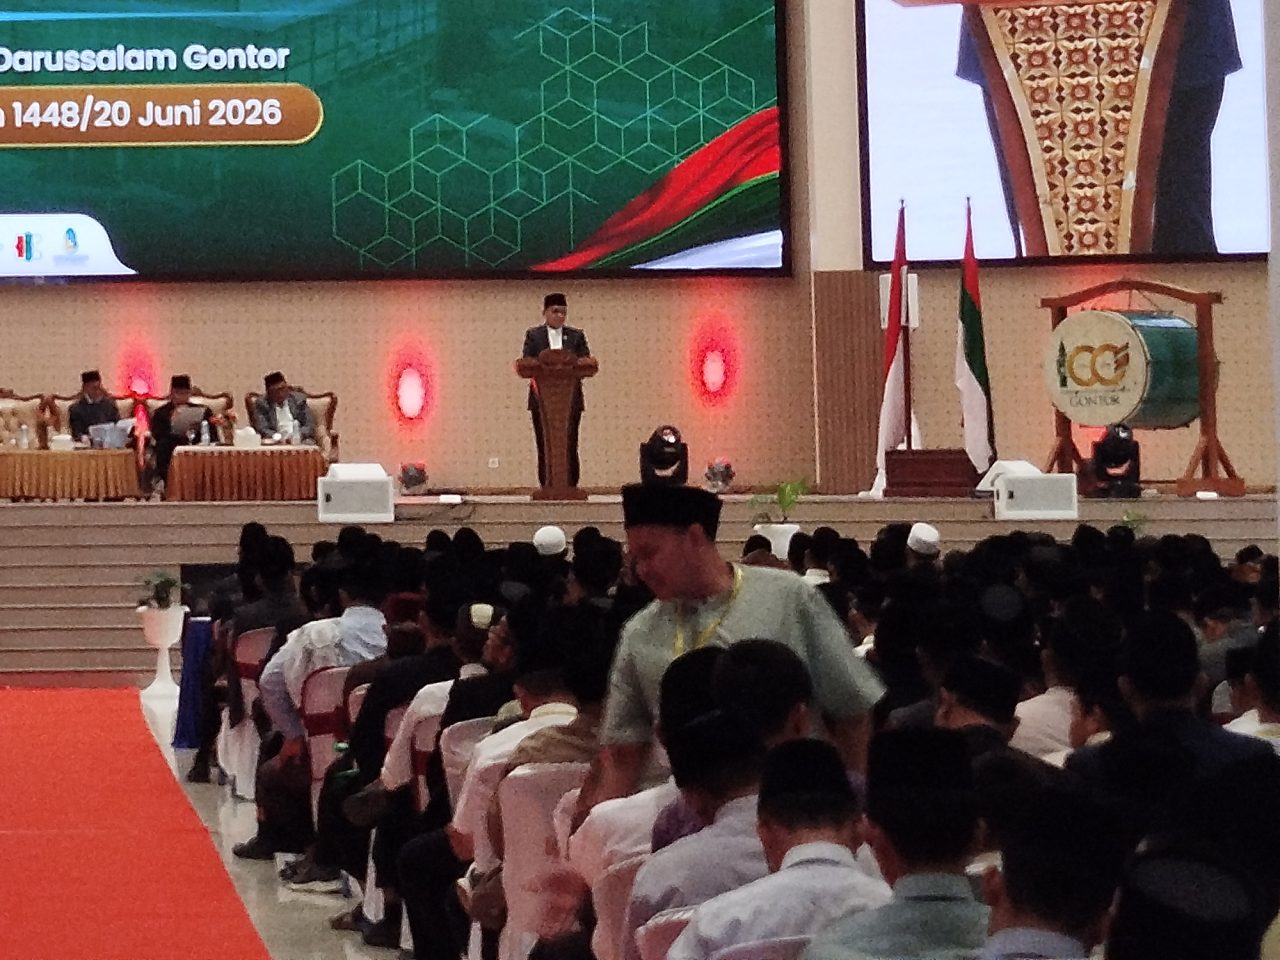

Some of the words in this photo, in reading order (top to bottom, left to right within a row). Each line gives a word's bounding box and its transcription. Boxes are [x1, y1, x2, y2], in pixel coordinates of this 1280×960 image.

[182, 44, 290, 70] Gontor
[11, 94, 131, 132] 1448/20
[137, 98, 201, 127] Juni
[207, 98, 282, 126] 2026
